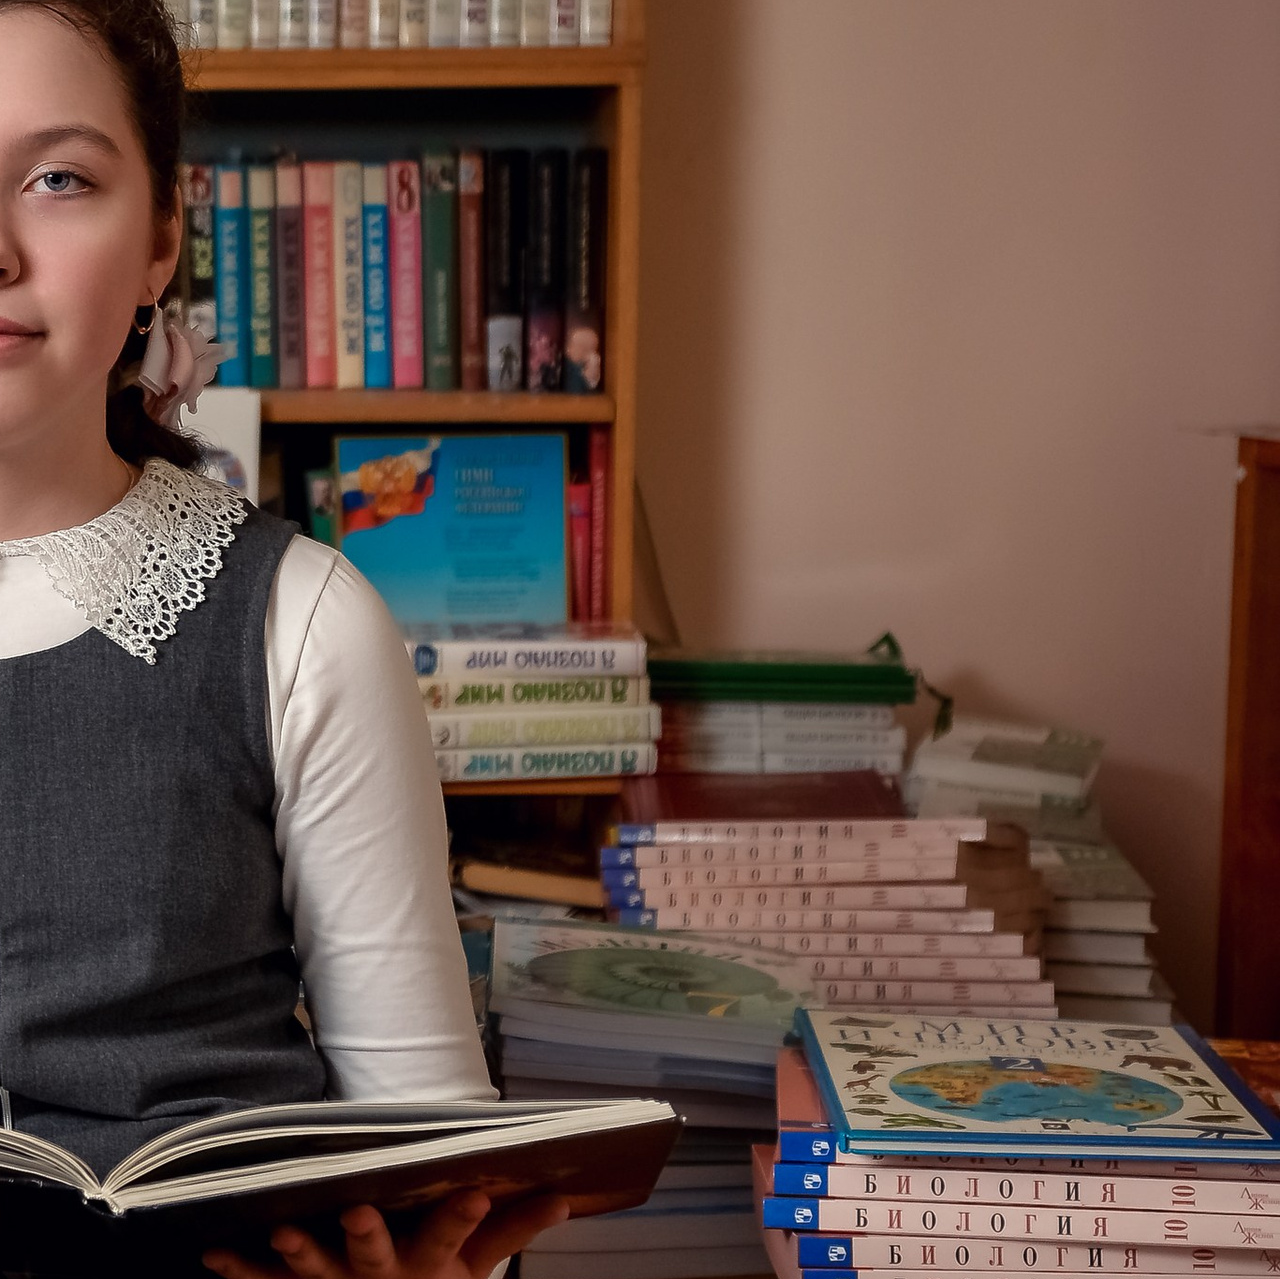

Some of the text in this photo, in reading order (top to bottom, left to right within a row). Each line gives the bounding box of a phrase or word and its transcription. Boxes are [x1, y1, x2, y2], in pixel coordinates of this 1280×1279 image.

[466, 650, 616, 669] Я ПОЗНАЮ МИР
[455, 678, 629, 705] Я ПОЗНАЮ МИР
[464, 750, 638, 774] Я ПОЗНАЮ МИР
[659, 843, 828, 864] БИОЛОГИЯ
[669, 891, 836, 908] БИОЛОГИЯ
[686, 991, 742, 1017] 7
[893, 1030, 1177, 1054] ЧЕЛОВЕК
[920, 1021, 1077, 1039] МИР
[1002, 1058, 1035, 1070] 2
[864, 1174, 1195, 1207] БИОЛОГИЯ 10
[855, 1208, 1188, 1241] БИОЛОГИЯ 10
[889, 1245, 1216, 1270] БИОЛОГИЯ 10
